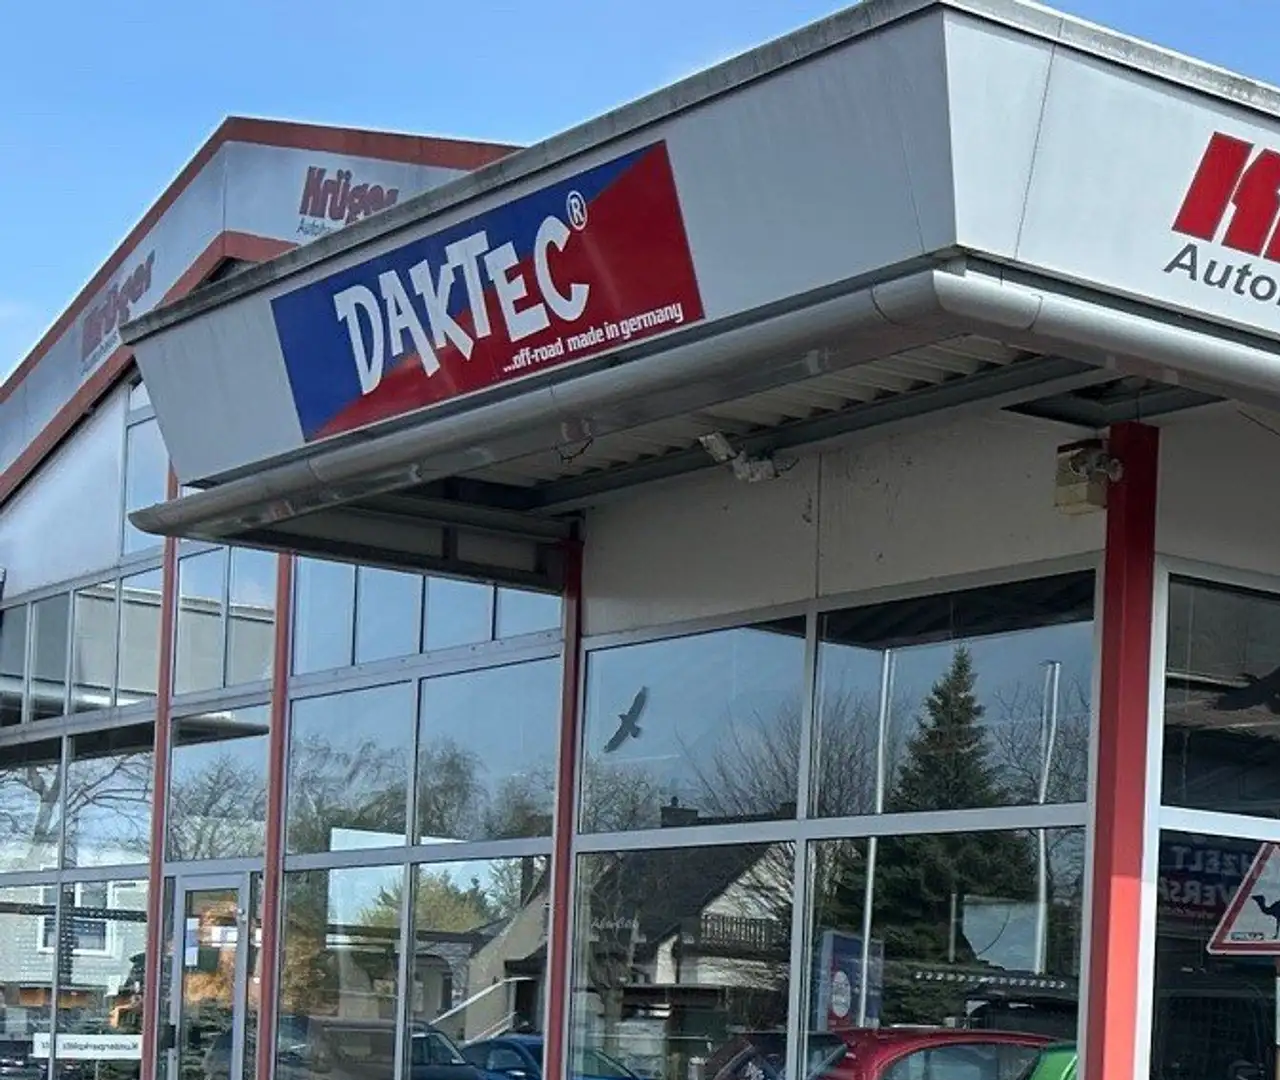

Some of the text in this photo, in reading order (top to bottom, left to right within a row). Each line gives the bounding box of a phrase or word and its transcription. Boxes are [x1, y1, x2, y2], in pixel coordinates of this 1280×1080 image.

[567, 326, 605, 352] made
[604, 321, 620, 341] in
[620, 302, 684, 340] germany
